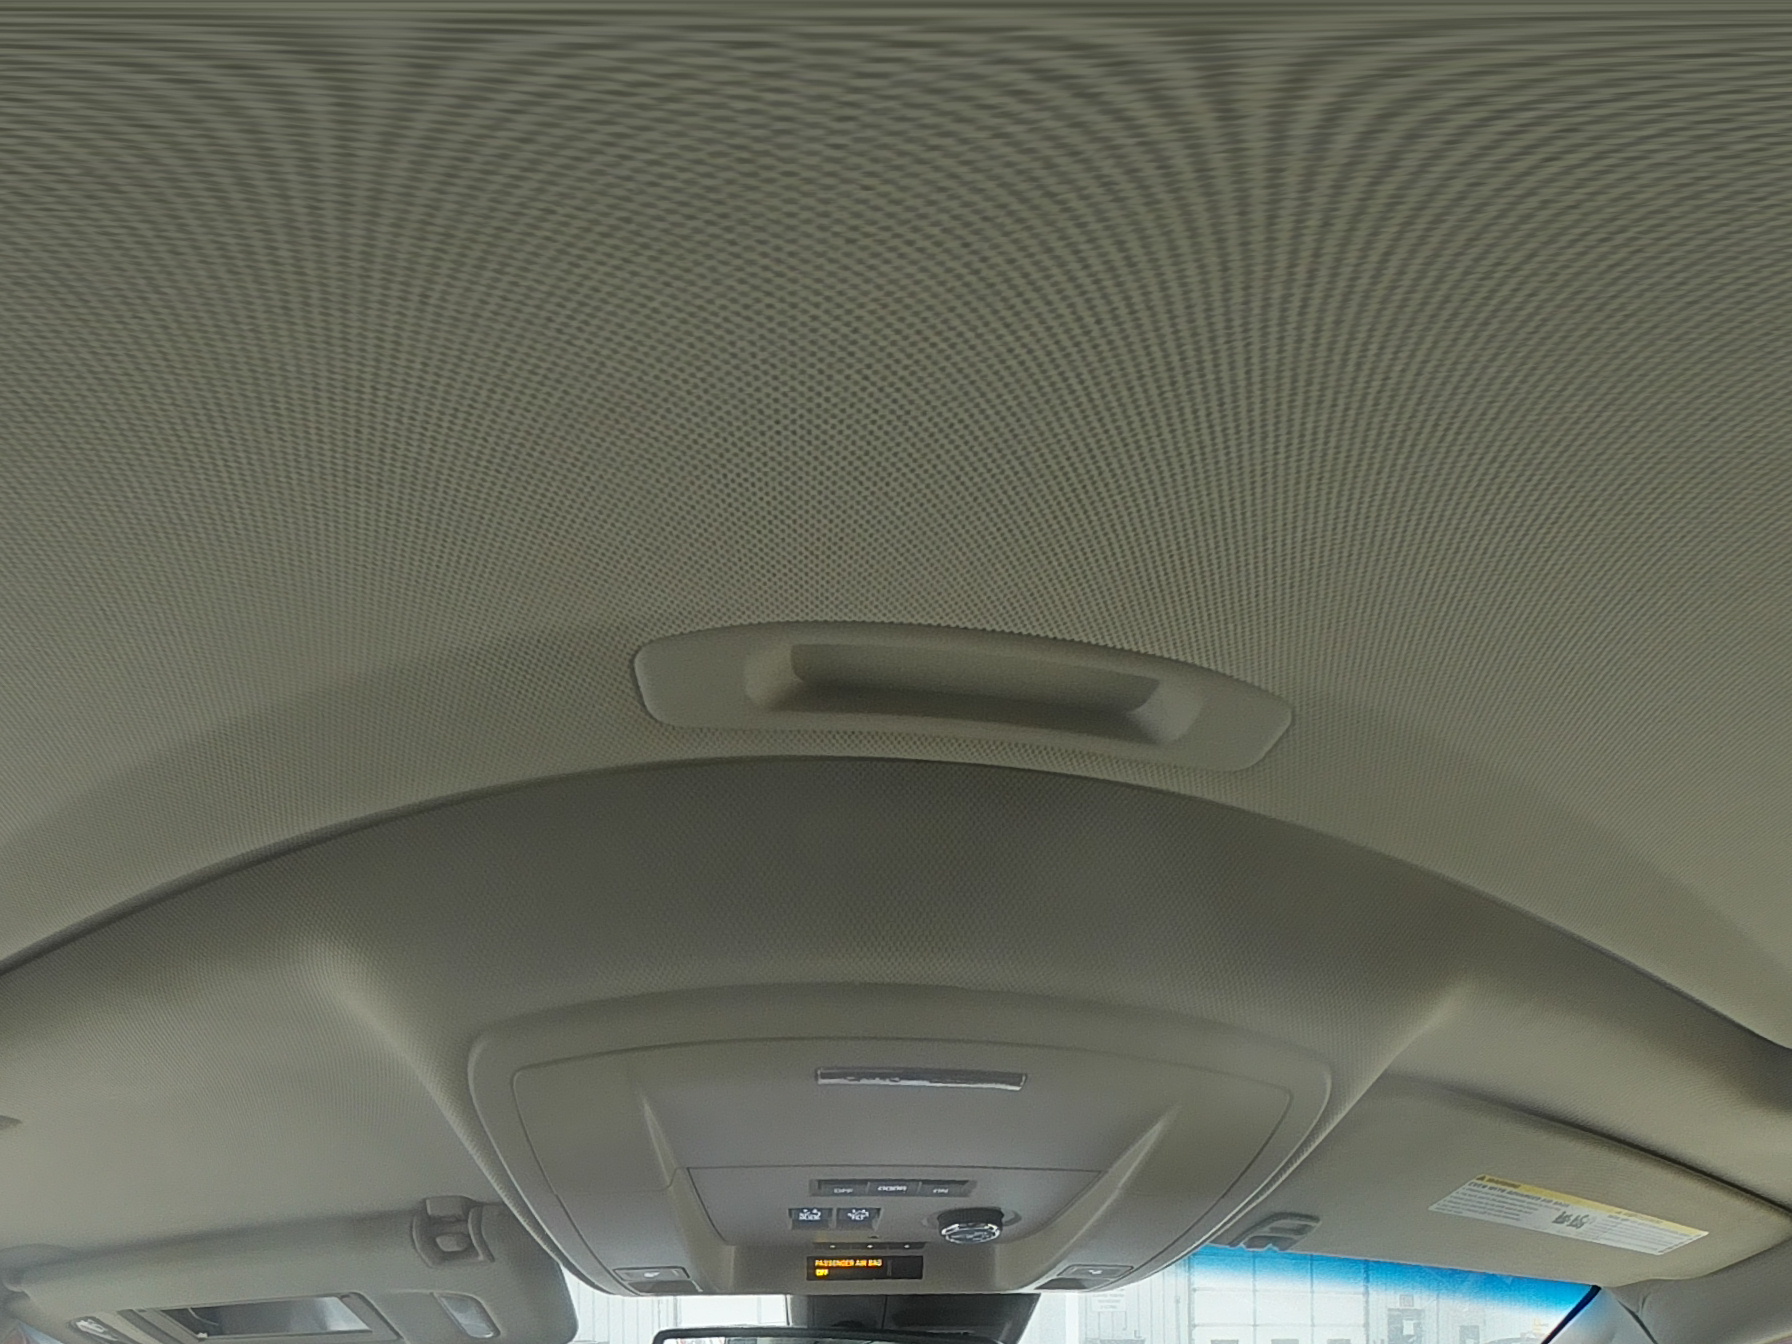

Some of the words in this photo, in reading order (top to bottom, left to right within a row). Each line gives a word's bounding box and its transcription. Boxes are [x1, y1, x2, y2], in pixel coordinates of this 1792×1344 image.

[814, 1258, 855, 1267] PASSENGER
[855, 1259, 867, 1267] AIR
[868, 1259, 883, 1267] BAG
